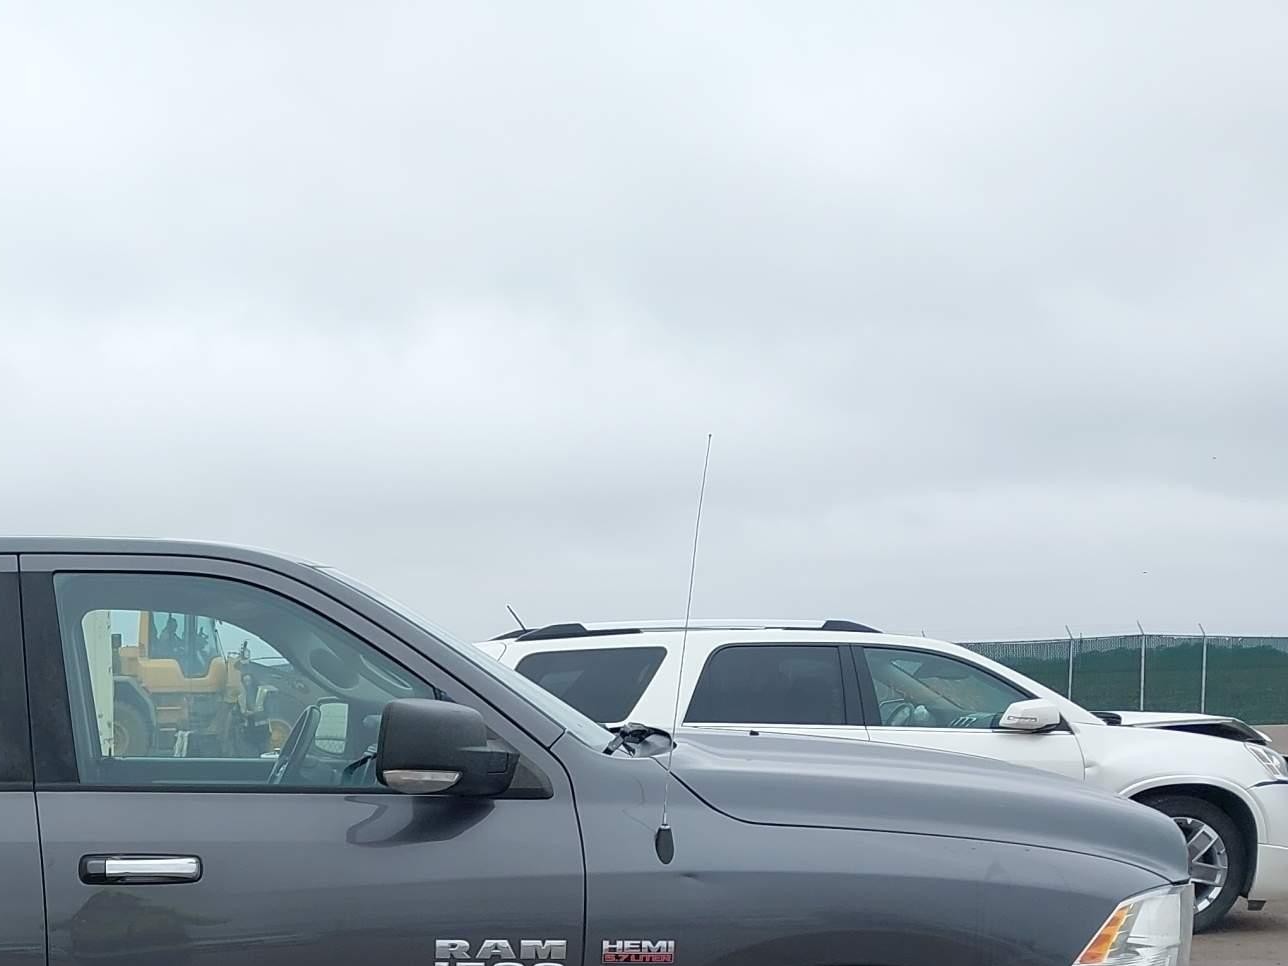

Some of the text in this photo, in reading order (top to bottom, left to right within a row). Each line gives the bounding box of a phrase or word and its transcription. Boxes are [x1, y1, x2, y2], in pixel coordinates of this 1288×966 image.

[434, 939, 567, 959] RAM
[602, 940, 675, 953] HEMI
[604, 954, 671, 962] 5.7 LITER
